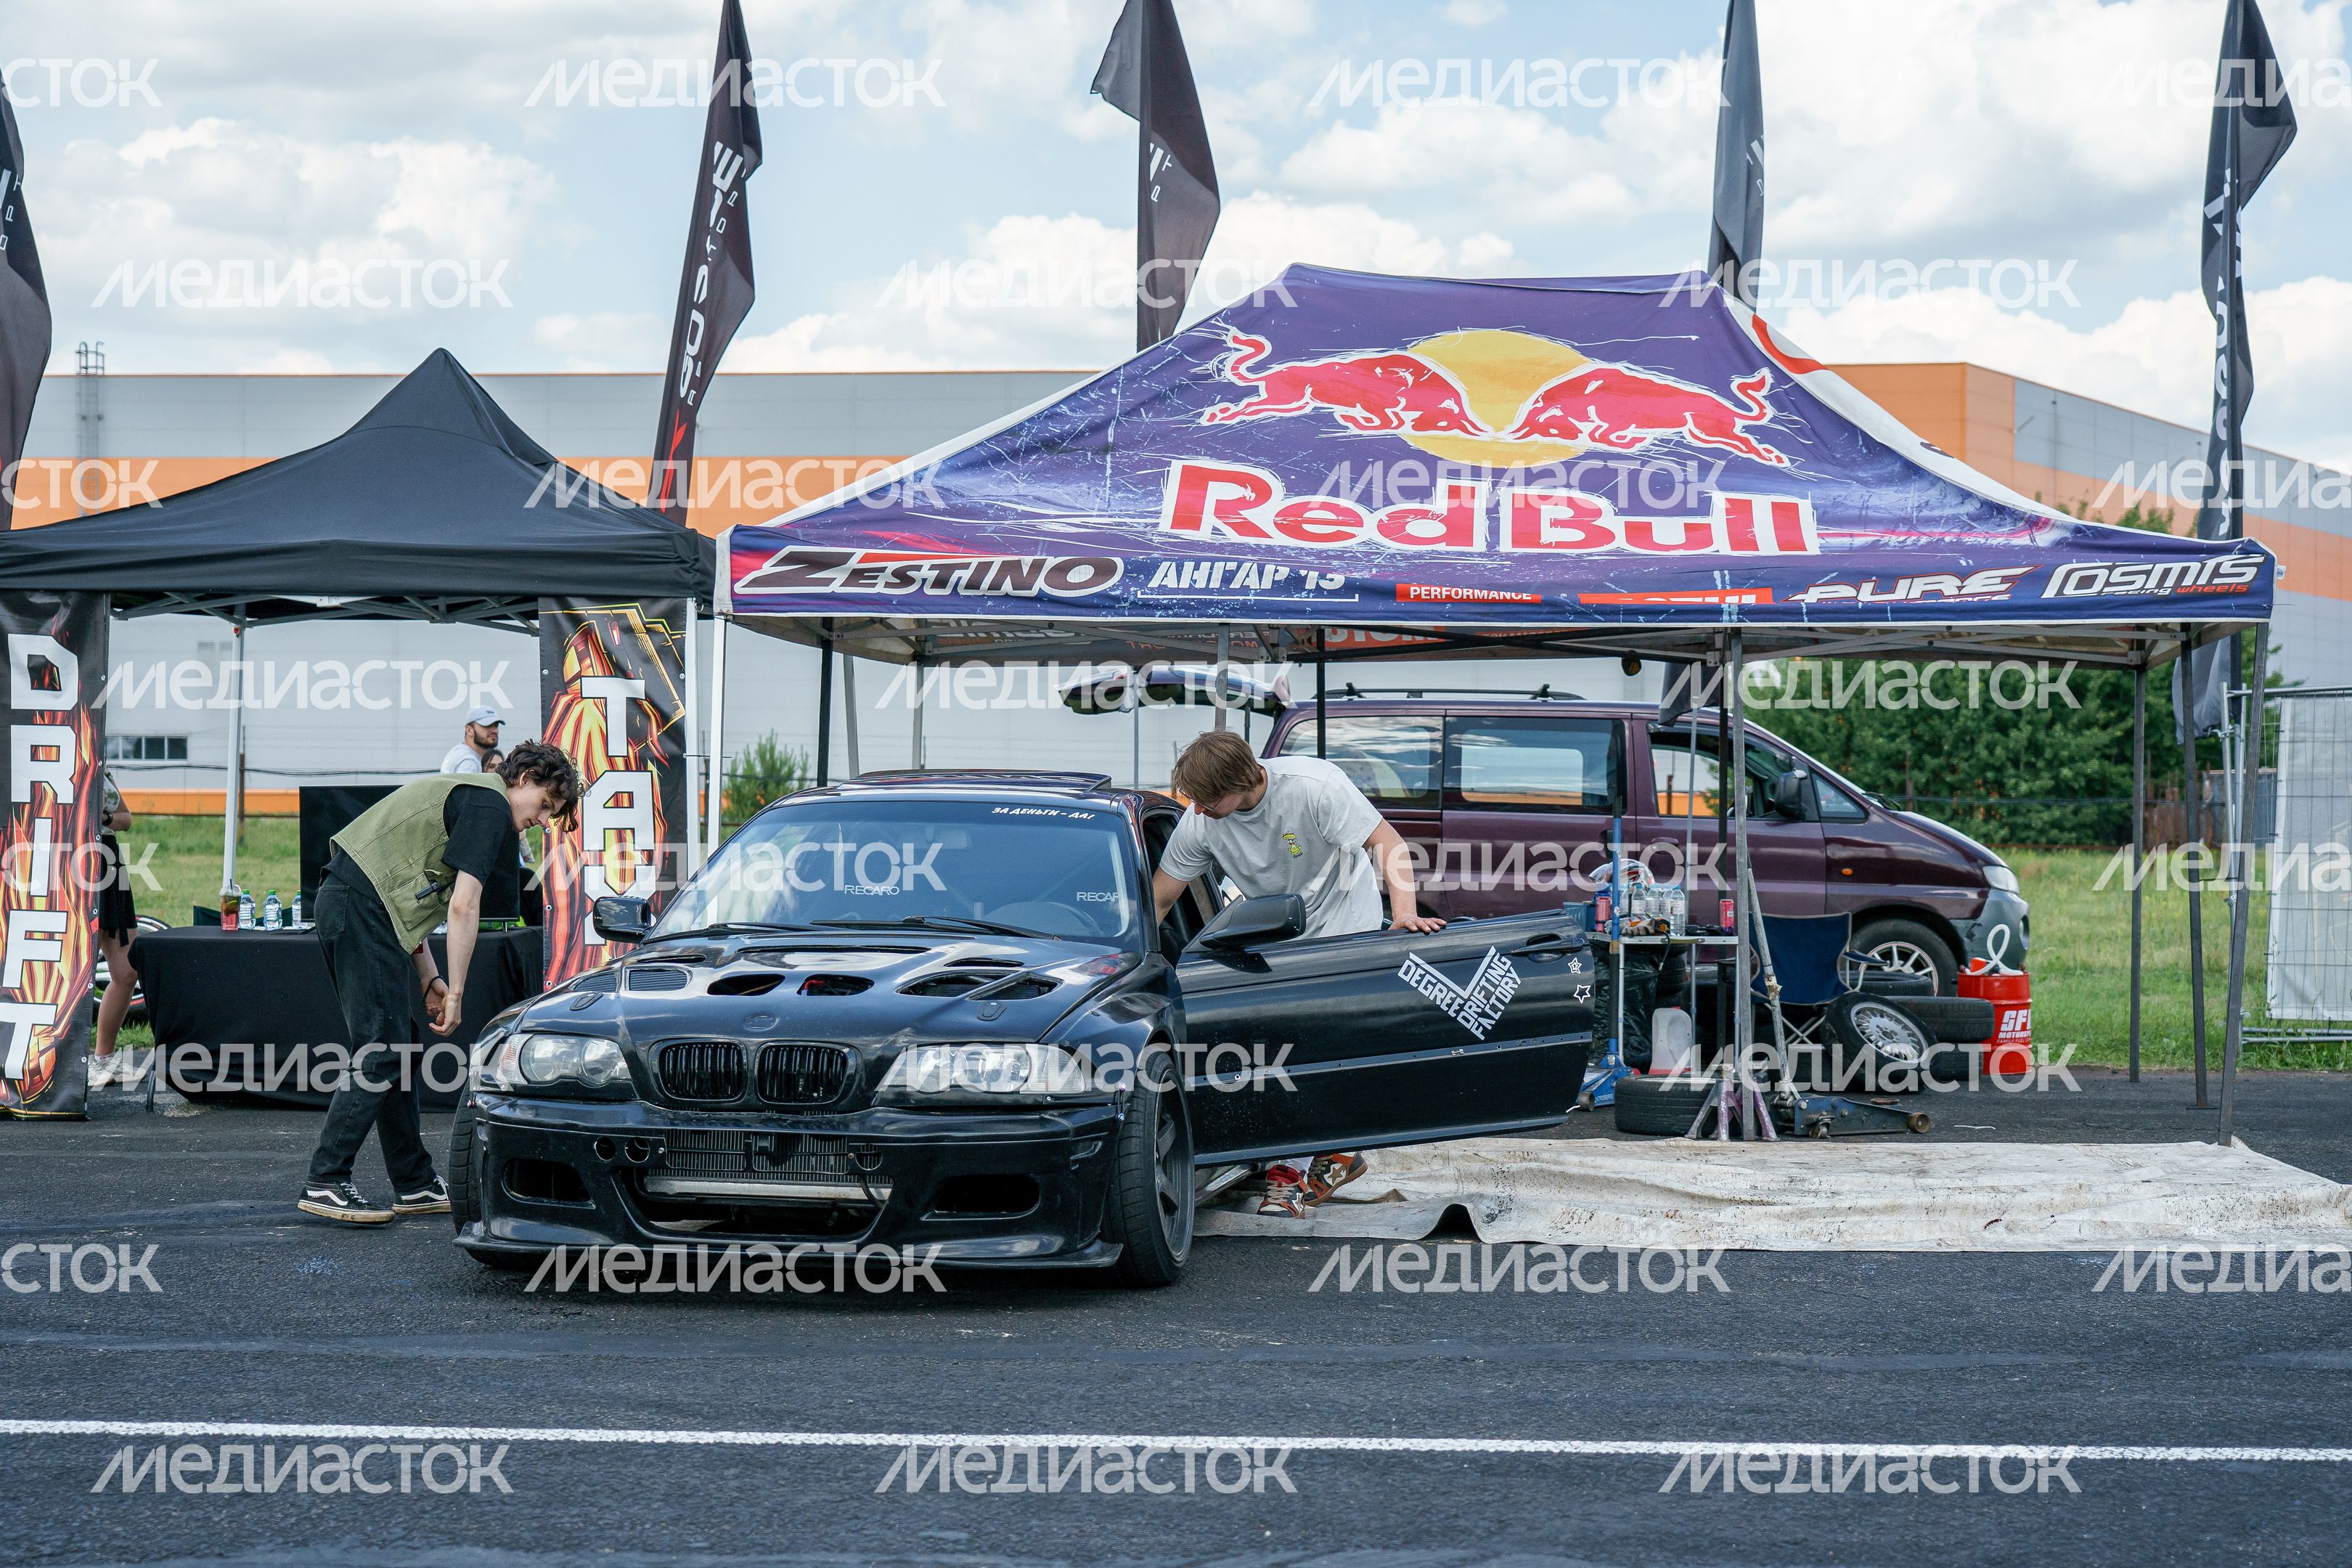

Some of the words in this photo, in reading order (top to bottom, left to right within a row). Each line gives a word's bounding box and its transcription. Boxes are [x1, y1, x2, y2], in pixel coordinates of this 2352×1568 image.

[1166, 460, 1484, 552] Red
[1503, 491, 1815, 555] Bull
[735, 546, 1124, 597] ZESTINO
[1148, 561, 1290, 589] АНГАР
[1781, 565, 2043, 604] PURE
[2176, 583, 2249, 593] wheels
[0, 633, 78, 1080] DRIFT
[844, 885, 900, 896] RECARO
[1397, 959, 1465, 1017] DEGREE
[1457, 952, 1512, 1029] DRIFTING
[1471, 966, 1522, 1040] FACTORY
